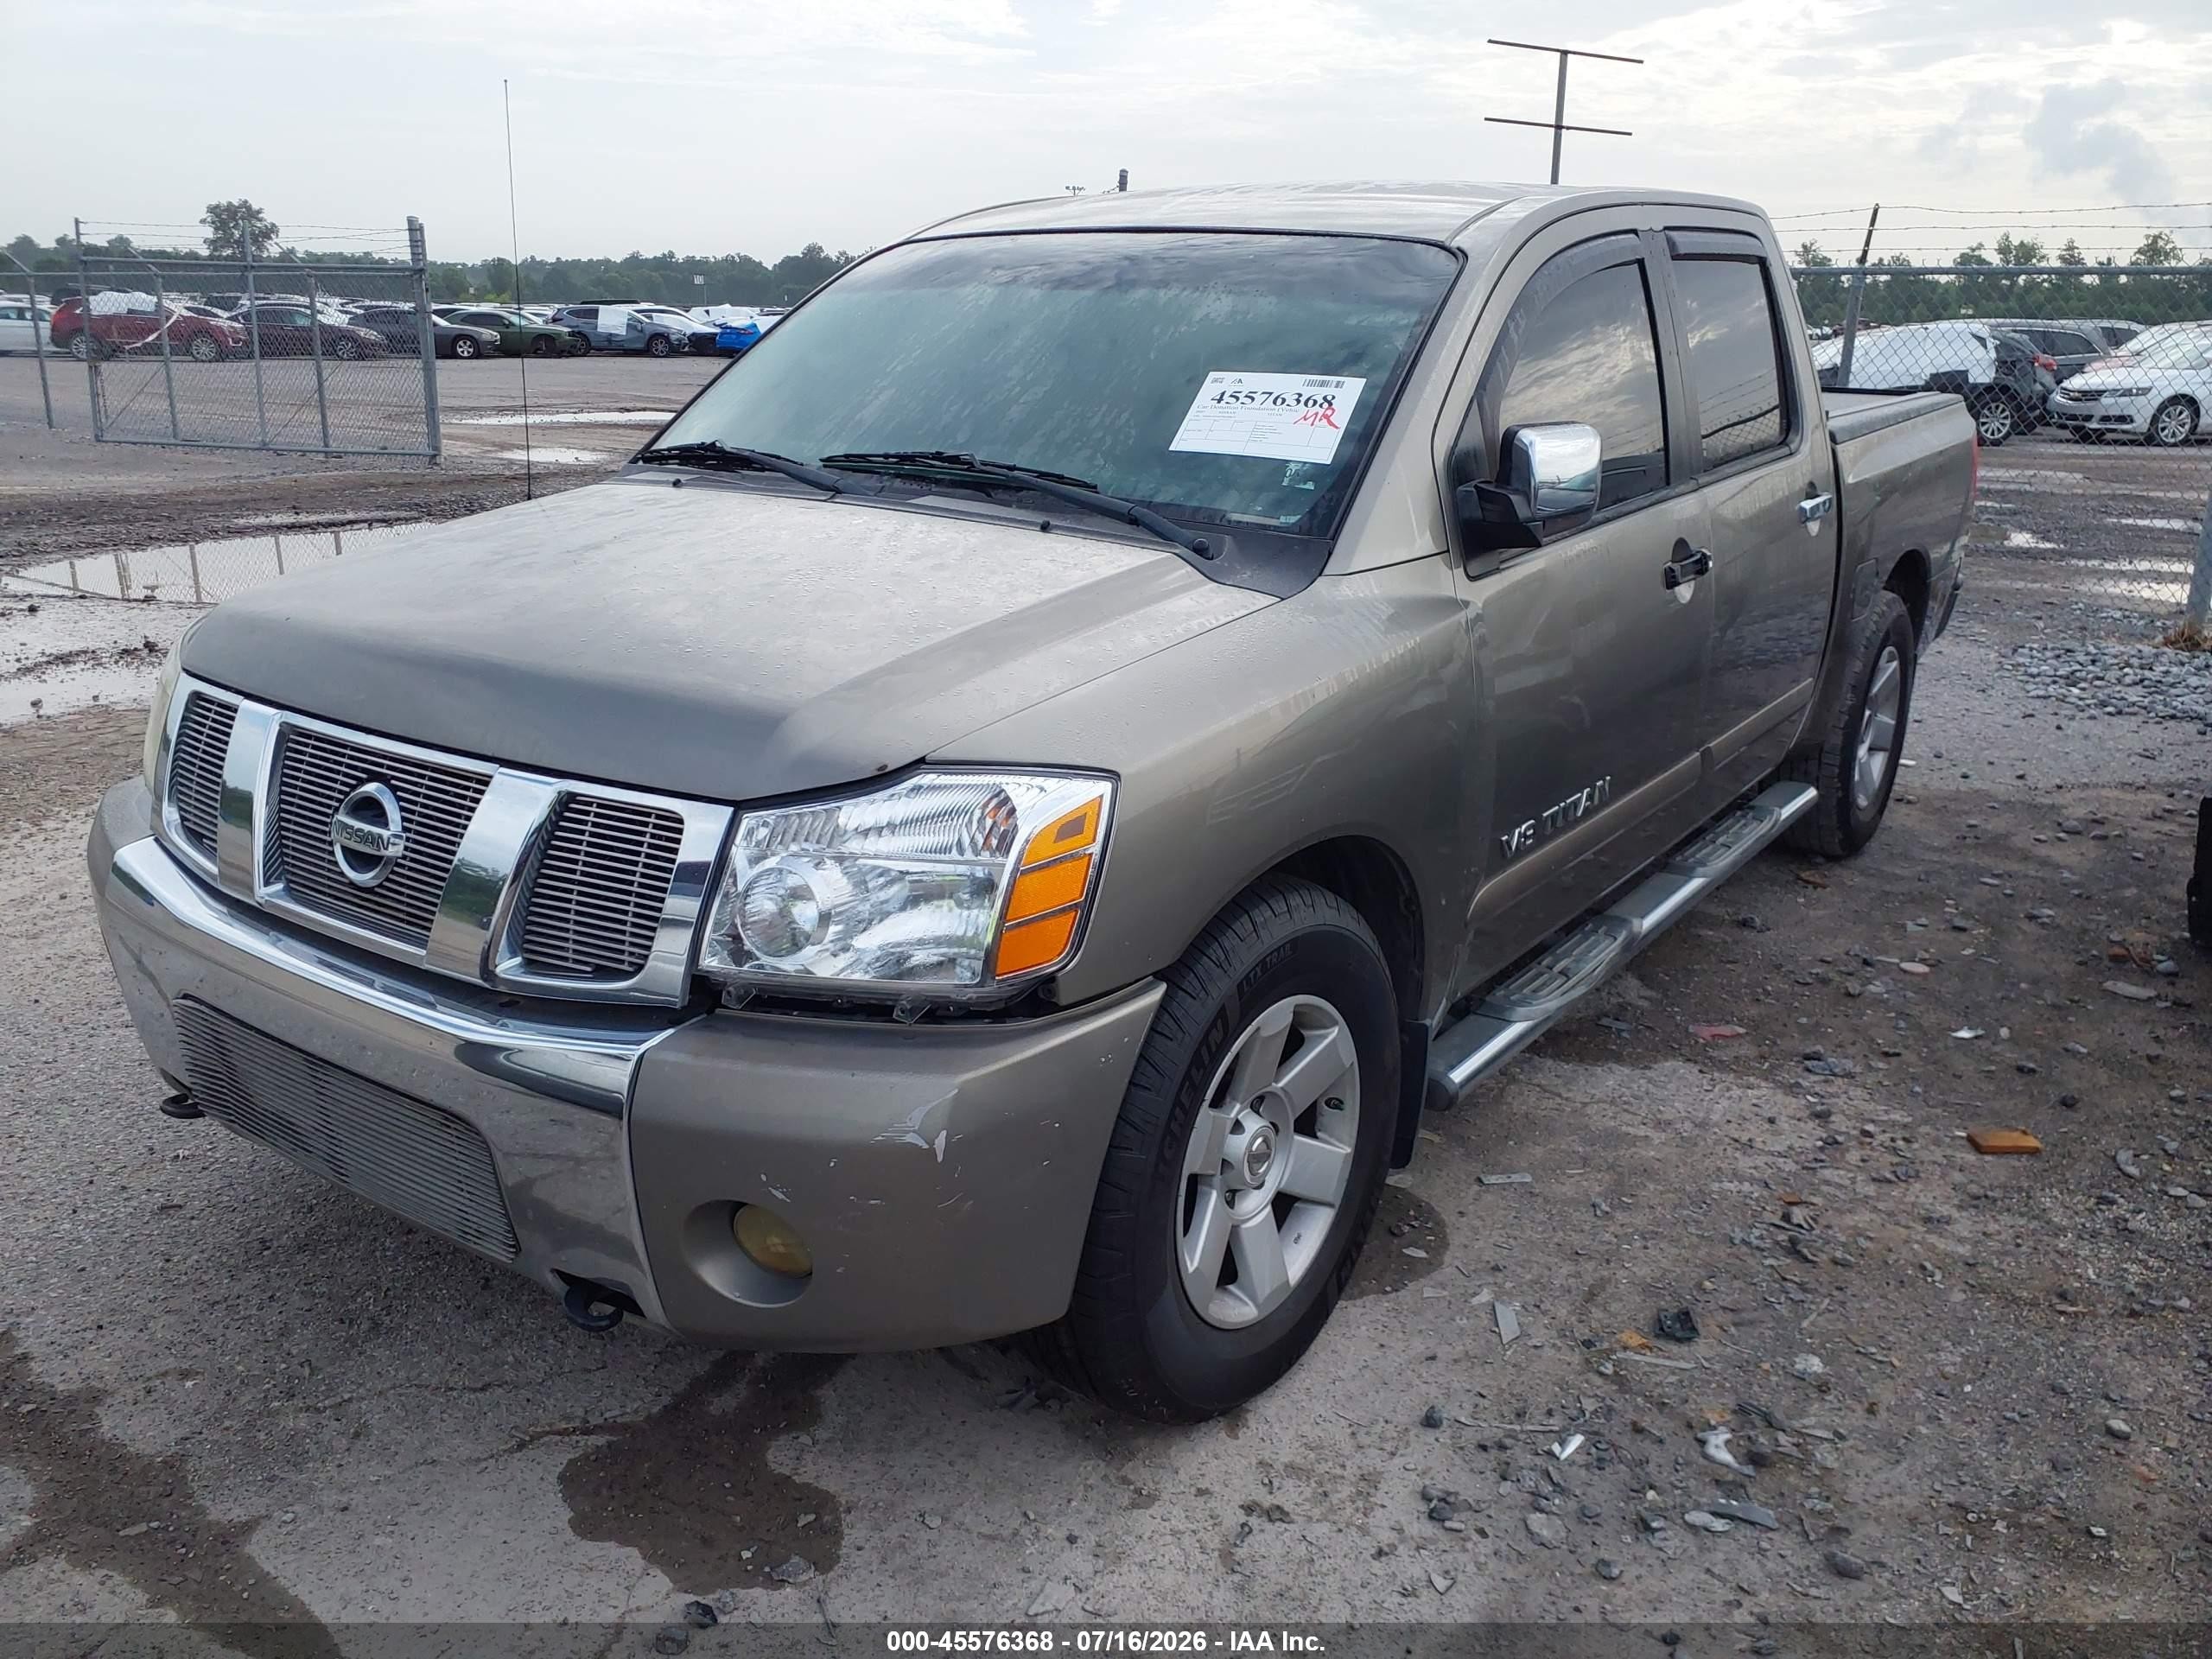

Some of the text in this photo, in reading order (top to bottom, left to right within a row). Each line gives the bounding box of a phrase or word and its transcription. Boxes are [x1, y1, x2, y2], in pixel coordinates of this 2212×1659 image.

[1210, 389, 1337, 410] 45576368
[1500, 775, 1611, 857] V8 TITAN
[332, 817, 391, 852] NISSAN
